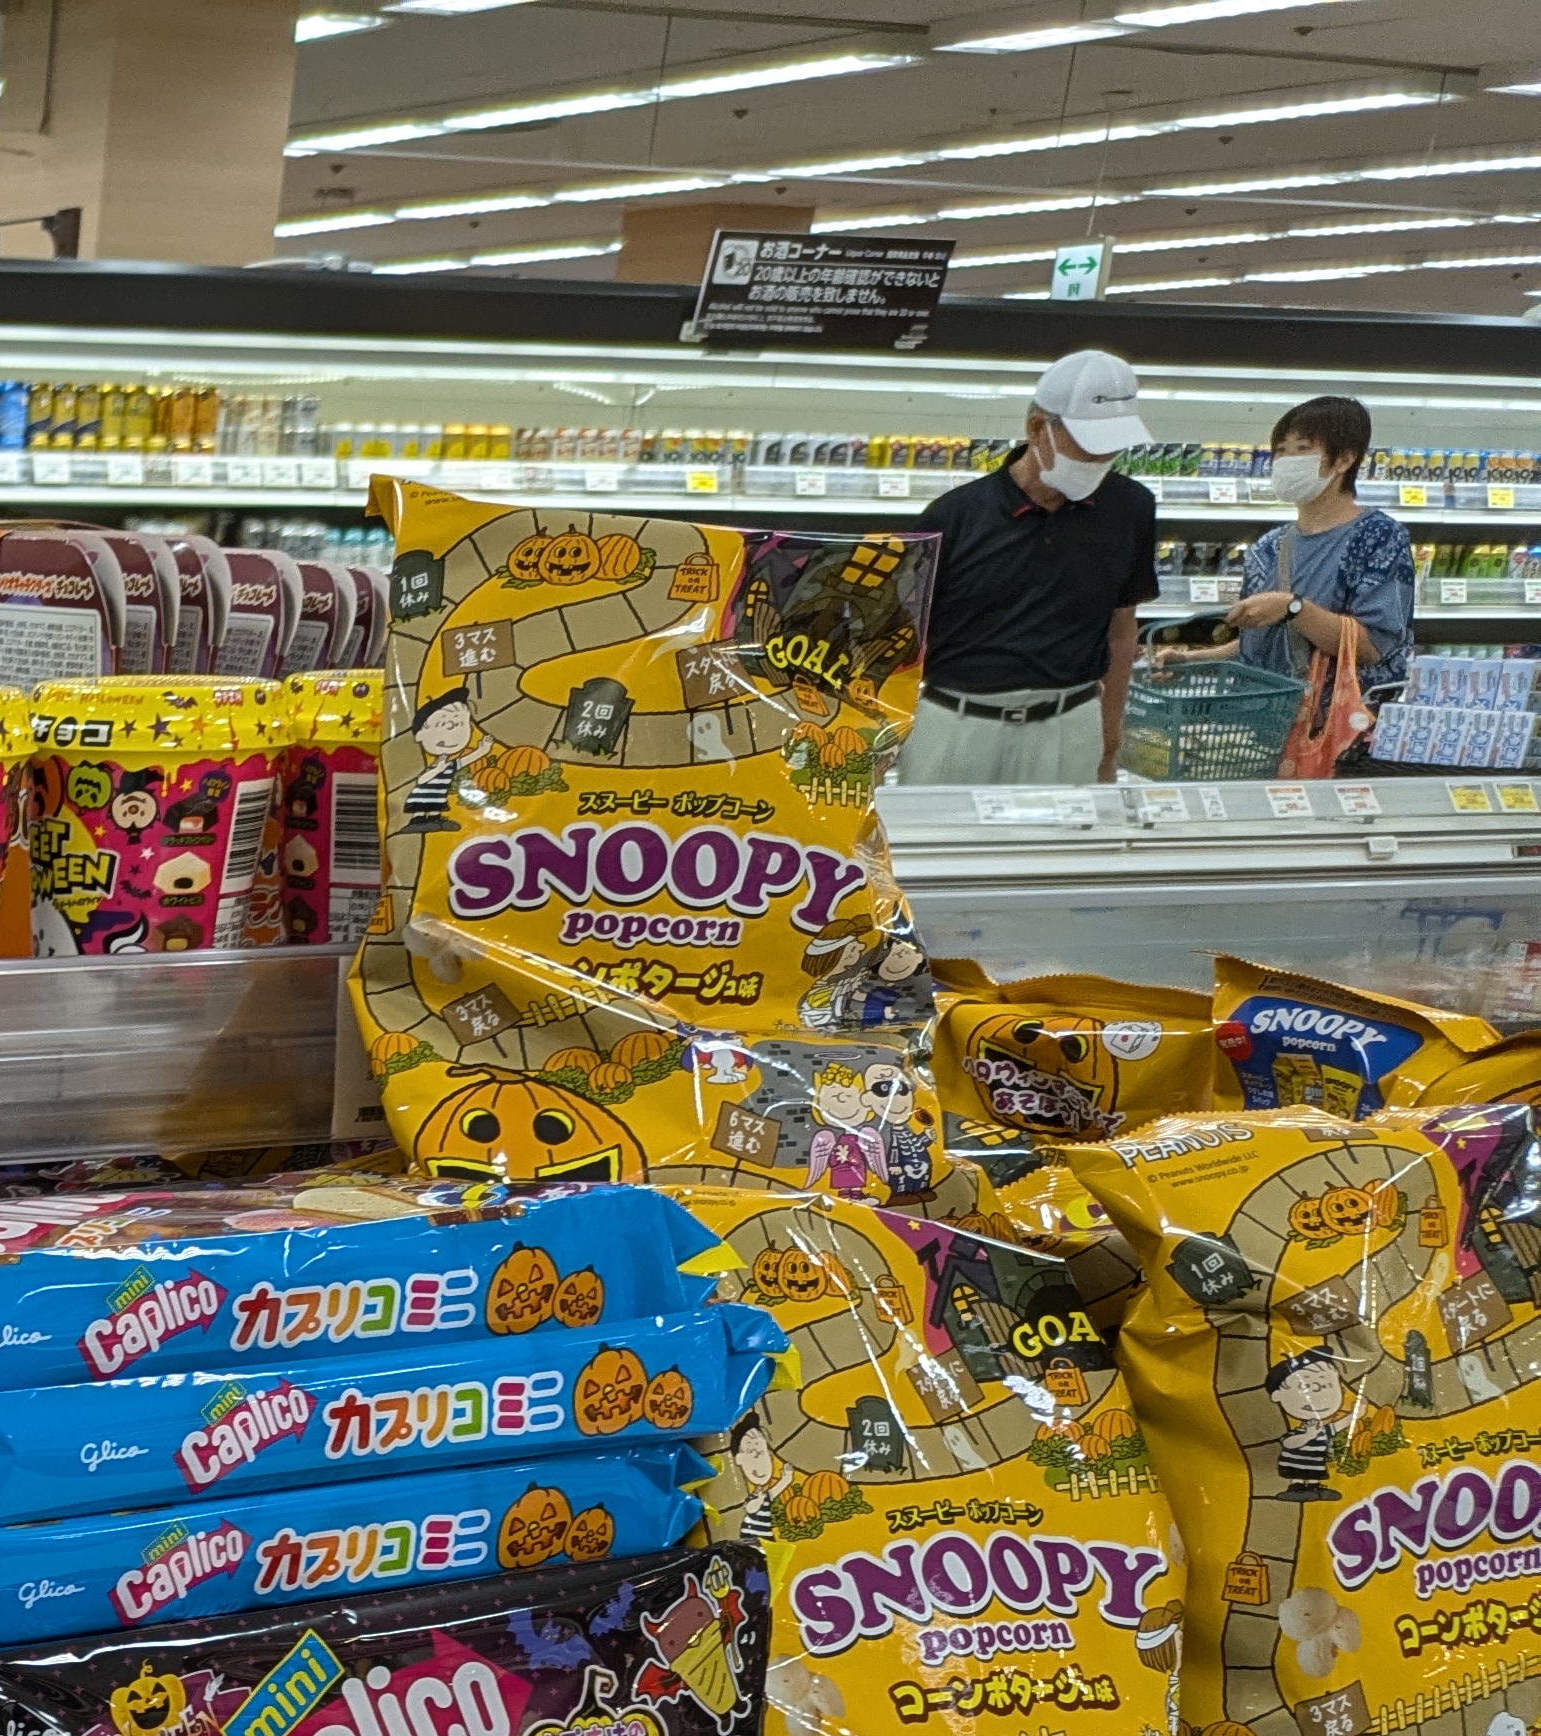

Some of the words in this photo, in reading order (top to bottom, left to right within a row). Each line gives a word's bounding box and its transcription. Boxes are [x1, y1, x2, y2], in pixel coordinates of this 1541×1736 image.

[454, 630, 498, 650] 3マス
[459, 648, 497, 668] 進む
[765, 635, 848, 688] GOAL
[576, 718, 609, 739] 休み
[580, 699, 615, 722] 2回
[580, 791, 670, 813] スヌーピー
[674, 792, 775, 822] ポップコーン
[452, 824, 866, 928] SNOOPY
[563, 907, 741, 946] popcorn
[1250, 1008, 1388, 1053] SNOOPY
[1109, 1125, 1254, 1169] PEANUTS
[80, 1274, 223, 1382] Caplico
[232, 1270, 480, 1351] カプリコミニ
[182, 1384, 313, 1493] Caplico
[325, 1370, 565, 1457] カプリコミニ
[80, 1439, 151, 1472] Glico
[17, 1579, 86, 1611] Glico
[792, 1536, 1166, 1656] SNOOPY
[918, 1619, 1073, 1666] popcorn
[891, 1671, 1119, 1722] コーンポタージュ味
